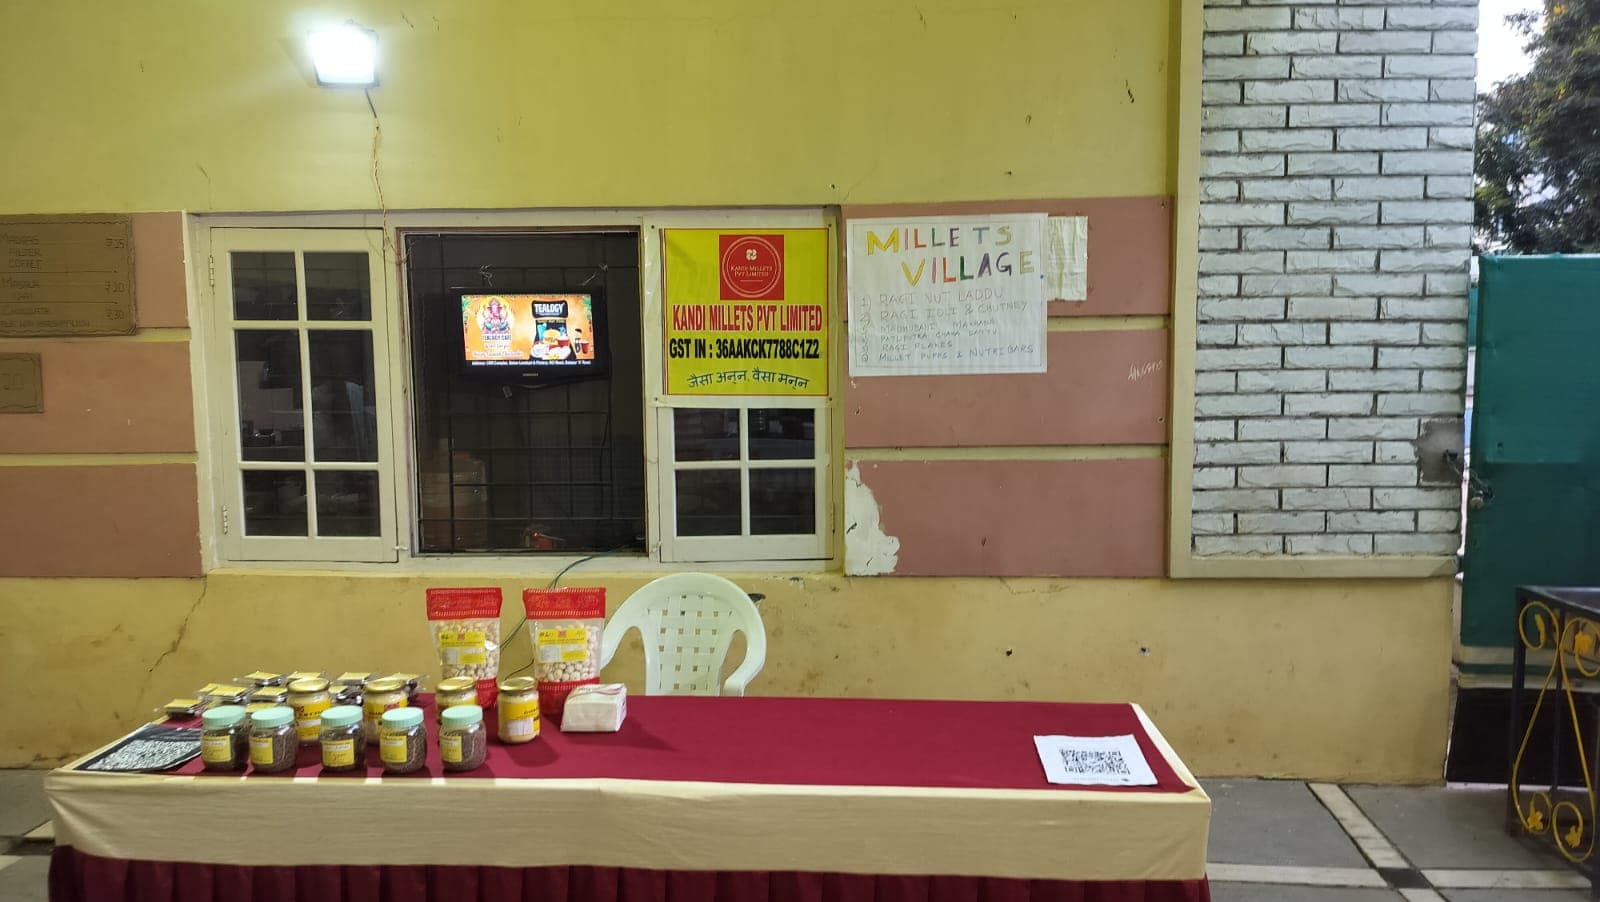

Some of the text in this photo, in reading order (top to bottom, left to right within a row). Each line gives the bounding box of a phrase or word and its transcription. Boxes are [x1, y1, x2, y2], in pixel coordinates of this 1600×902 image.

[866, 226, 1013, 256] MILLETS
[750, 264, 773, 272] MILLETS
[901, 250, 1035, 287] VILLAGE
[534, 302, 565, 313] TEALOGY
[880, 293, 914, 307] RAGI
[959, 287, 1004, 302] LADDU
[673, 304, 823, 332] KANDI MILLETS PVT LIMITED
[880, 308, 917, 322] RAGI
[669, 338, 820, 359] GST IN : 36AAKCK7788C1Z2
[687, 373, 714, 388] जैसा
[752, 366, 776, 383] वैसा
